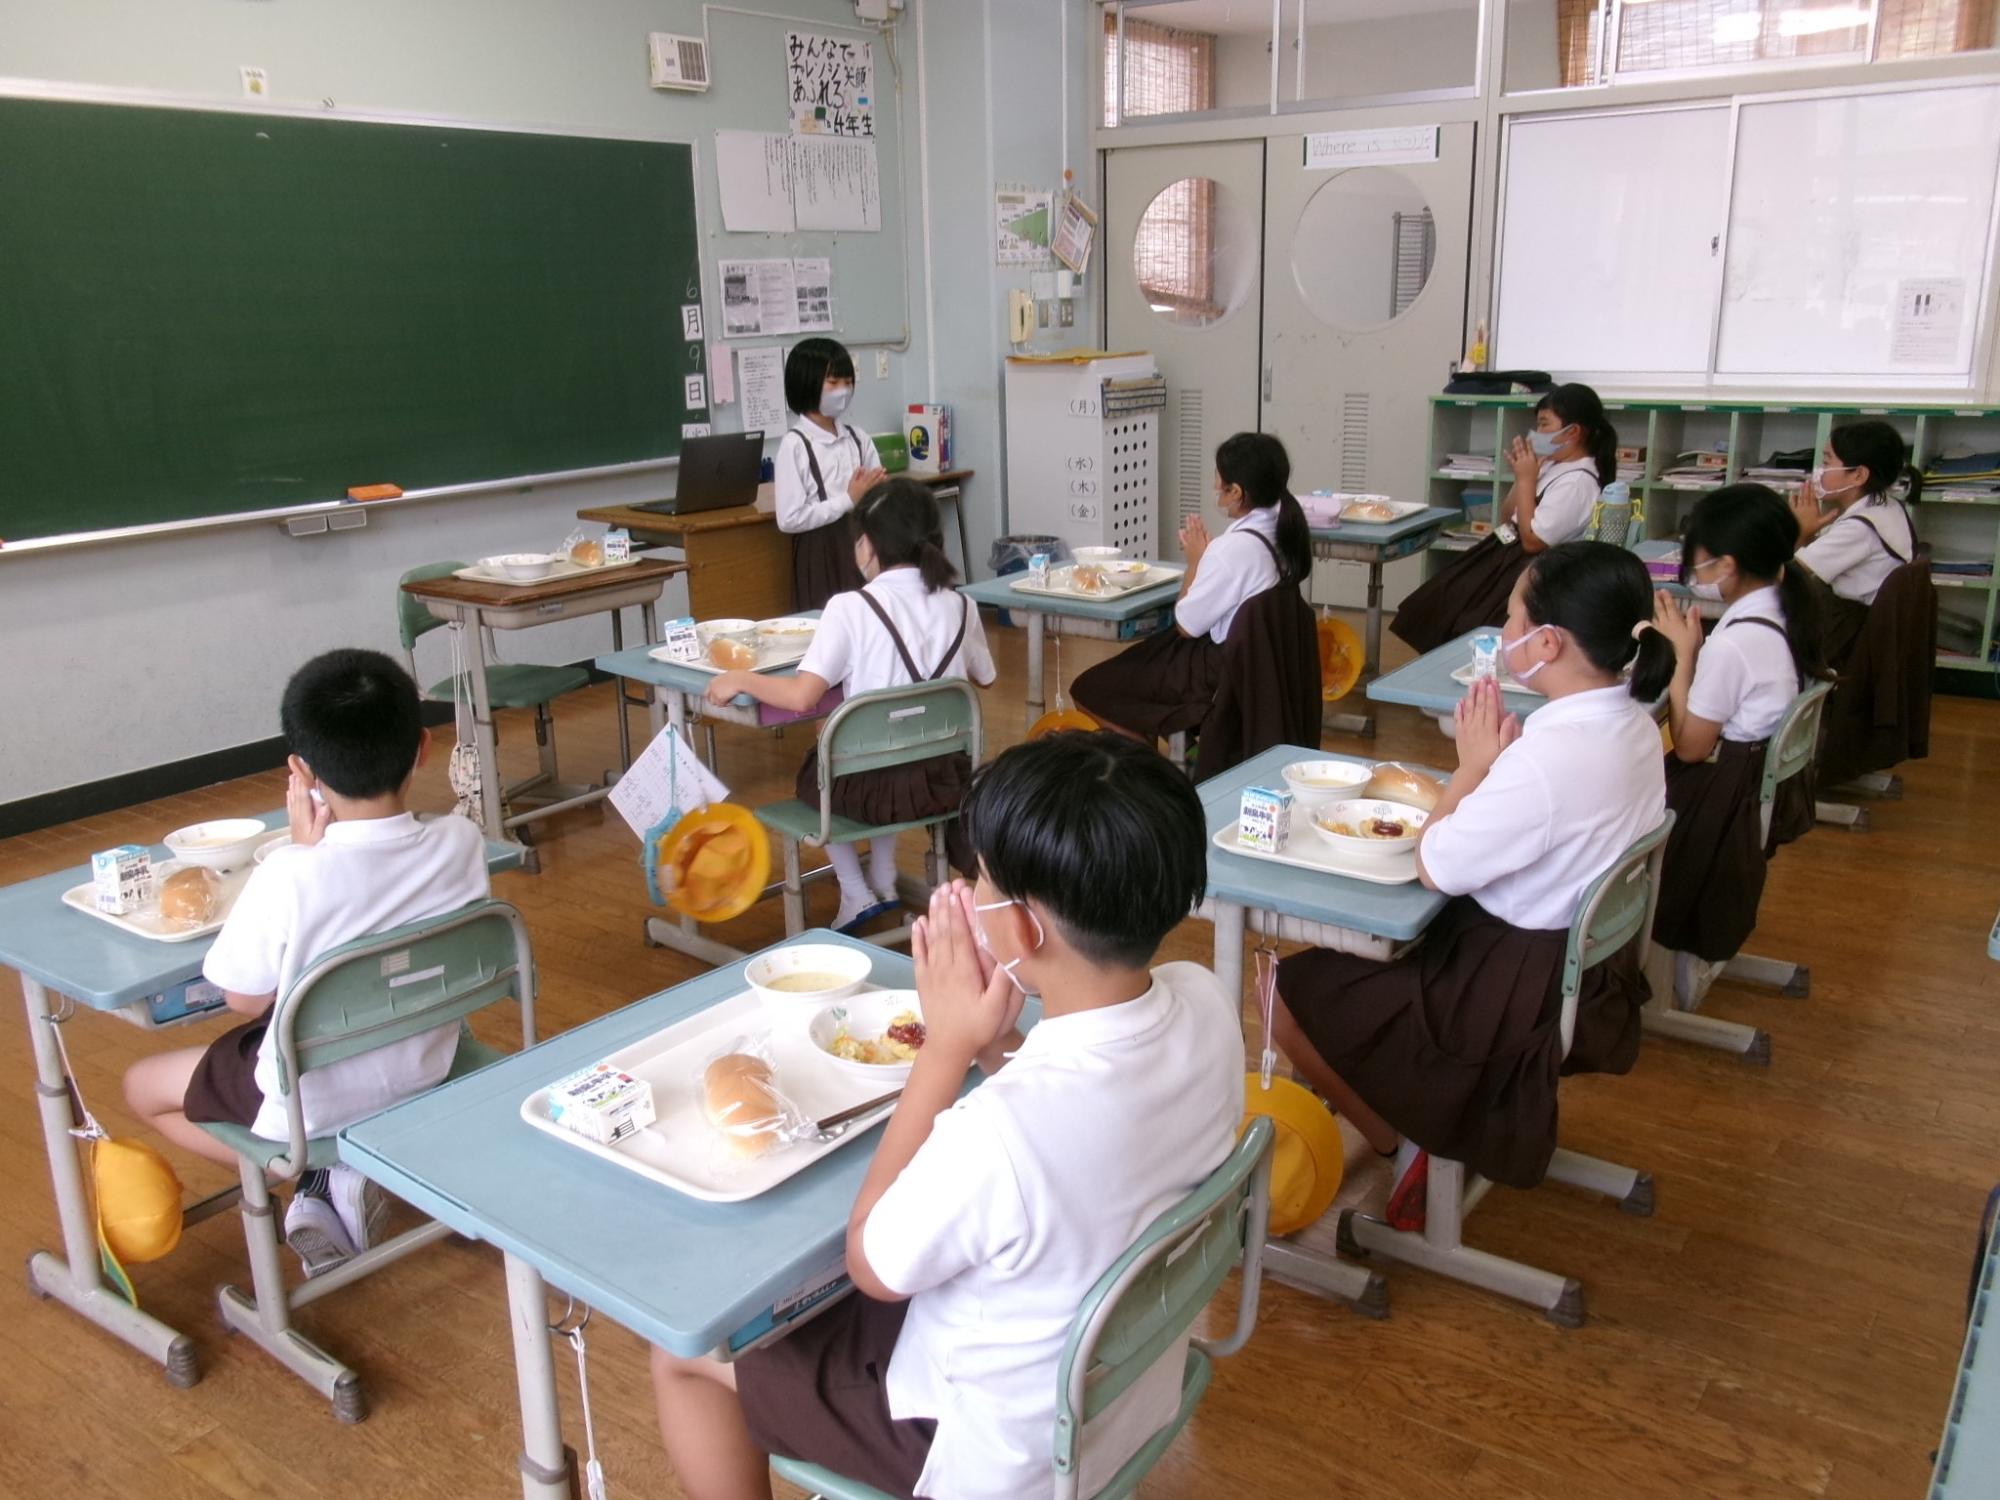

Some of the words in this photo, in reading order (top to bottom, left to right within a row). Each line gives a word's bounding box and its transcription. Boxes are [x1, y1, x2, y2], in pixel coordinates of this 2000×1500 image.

[790, 34, 855, 62] みんなで
[844, 65, 867, 89] 笑顔
[834, 111, 873, 136] 4年生
[686, 278, 697, 299] 6
[686, 308, 700, 334] 月
[688, 344, 701, 370] 9
[688, 381, 702, 402] 日
[1070, 399, 1096, 415] (月)
[1067, 456, 1094, 471] (水)
[1071, 503, 1097, 519] (金)
